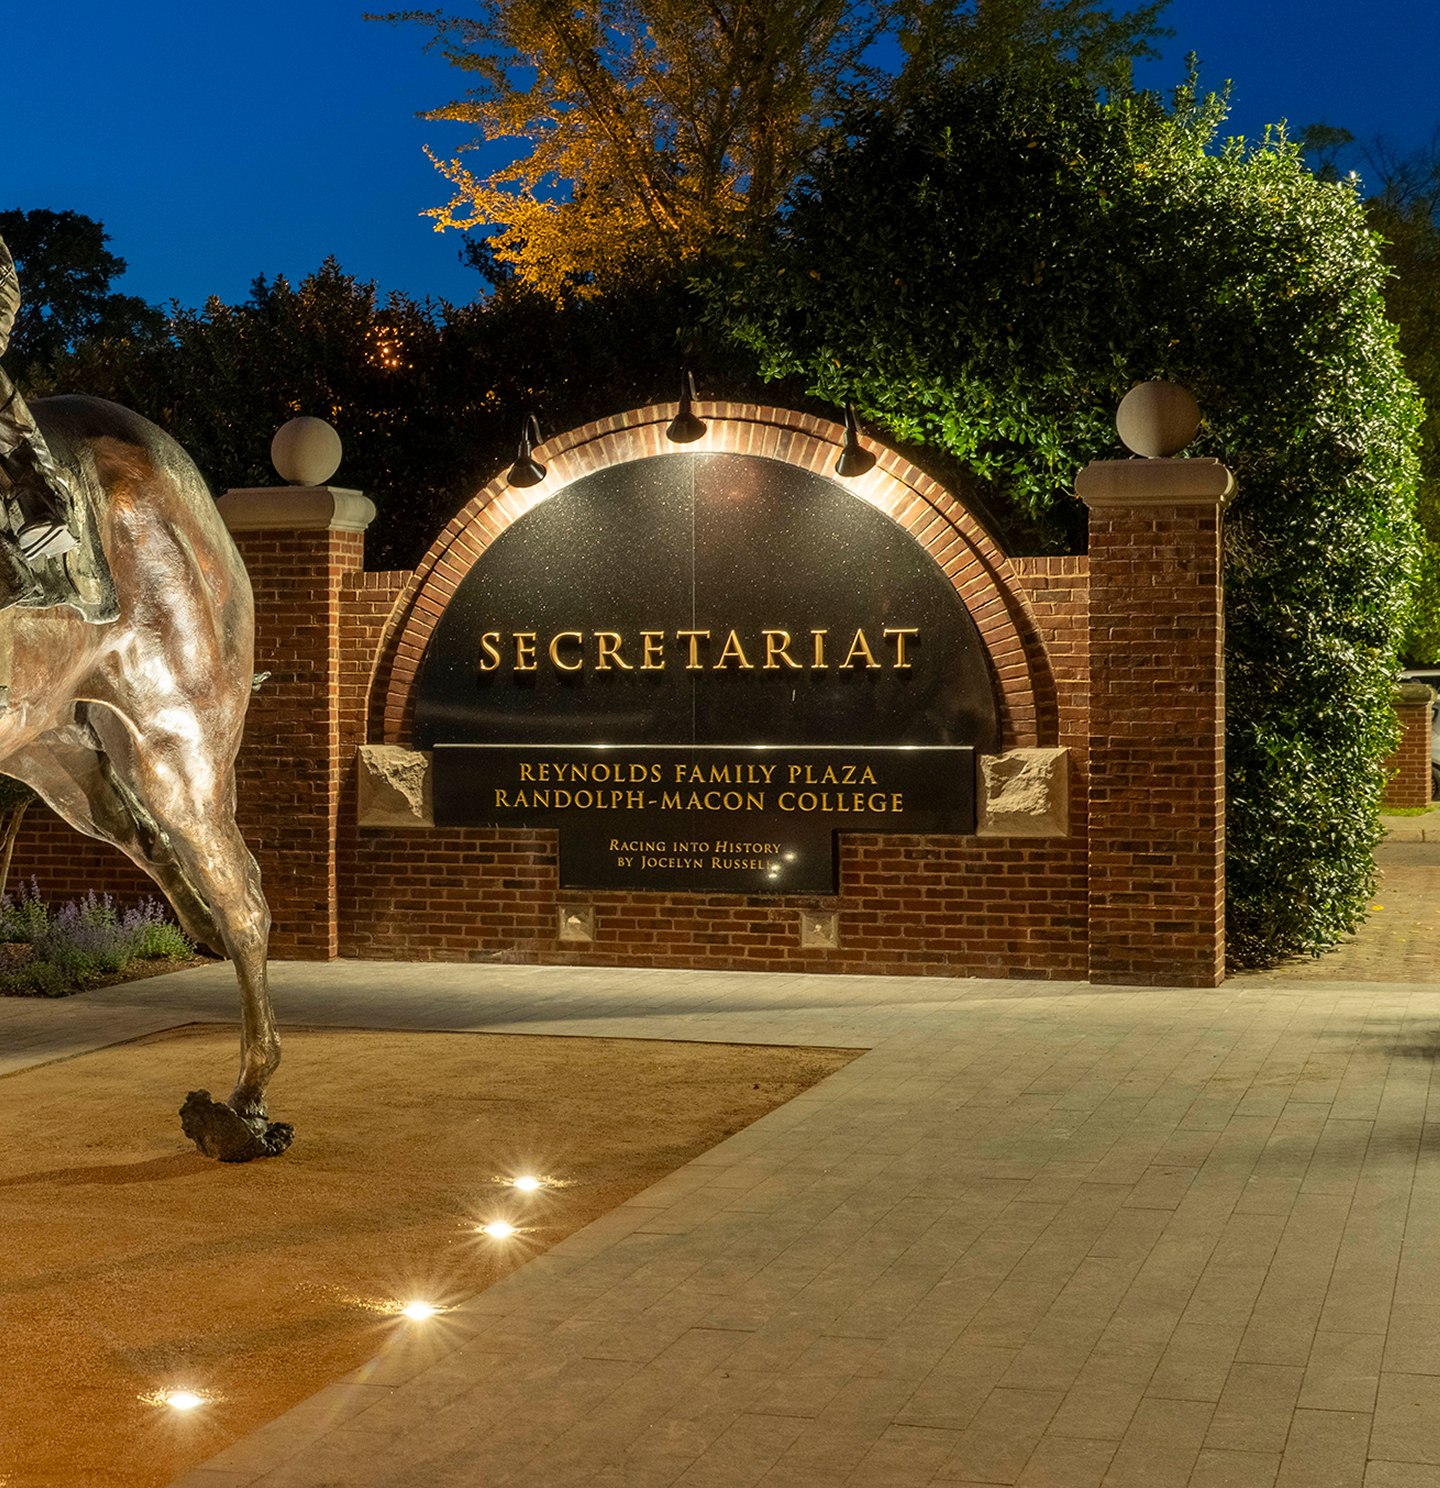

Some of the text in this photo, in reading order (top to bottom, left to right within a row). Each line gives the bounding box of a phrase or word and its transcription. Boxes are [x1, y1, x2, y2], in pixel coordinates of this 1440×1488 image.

[479, 627, 920, 671] SECRETARIAT
[519, 763, 878, 785] REYNOLDS FAMILY PLAZA
[494, 789, 904, 813] RANDOLPH-MACON COLLEGE
[610, 839, 781, 854] RACING INTO HISTORY
[617, 857, 633, 867] BY
[641, 856, 703, 870] JOCELYN
